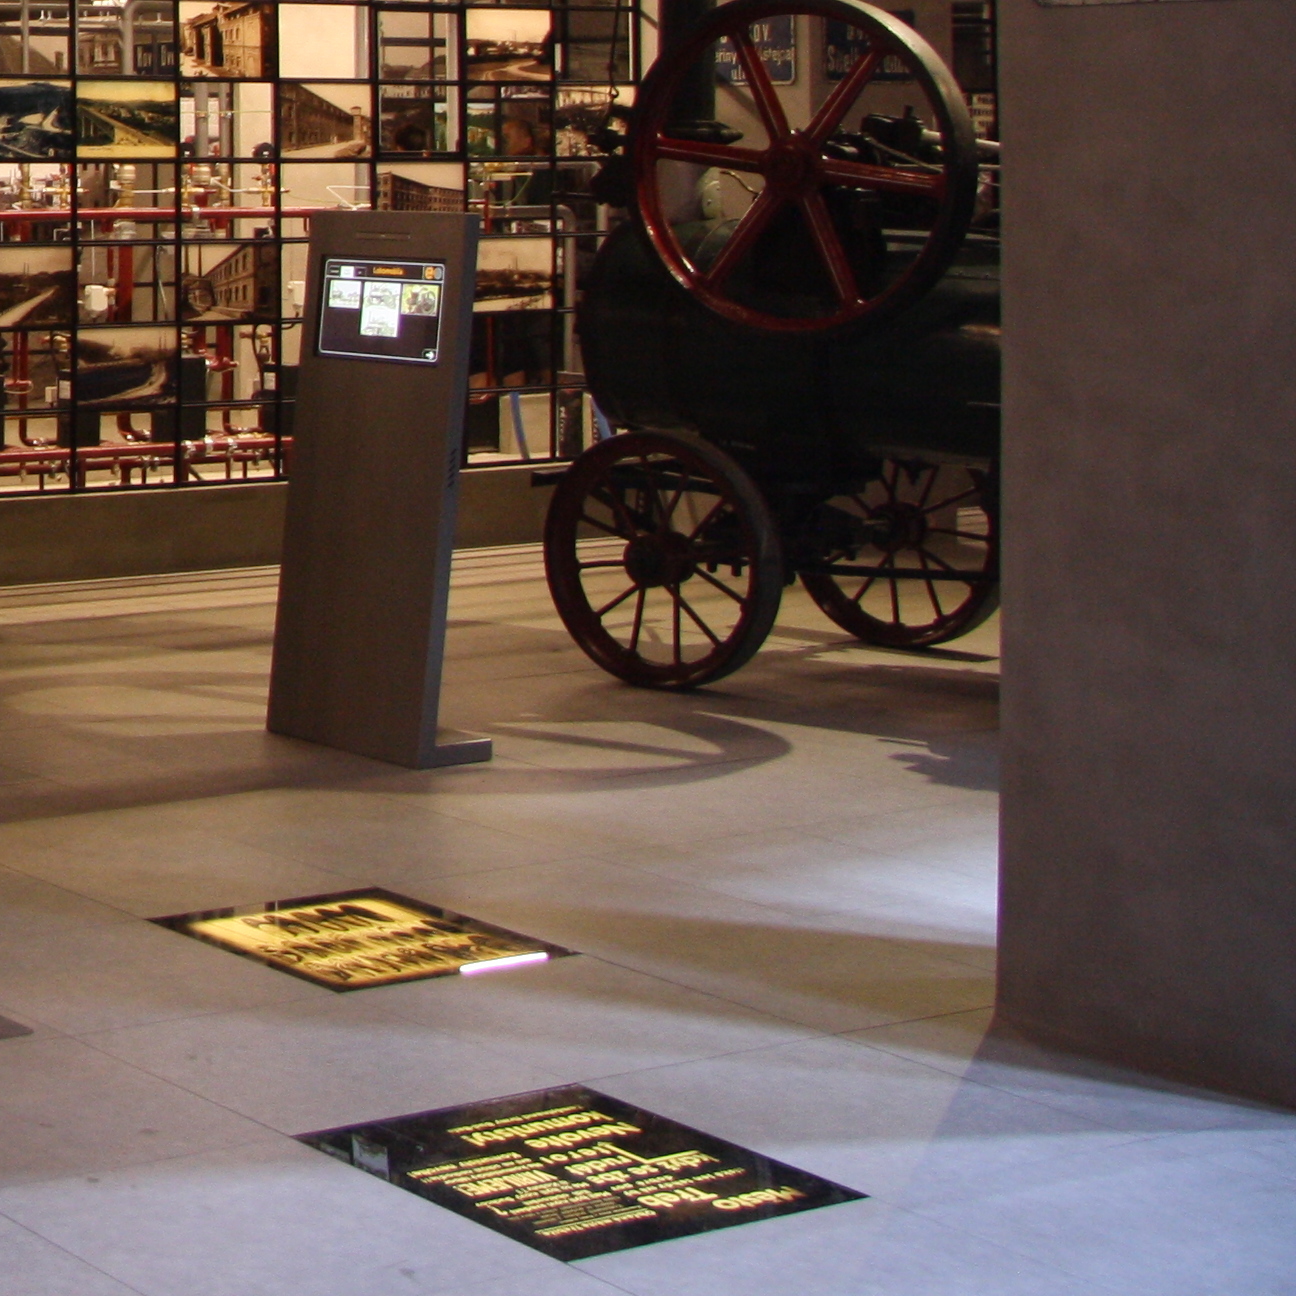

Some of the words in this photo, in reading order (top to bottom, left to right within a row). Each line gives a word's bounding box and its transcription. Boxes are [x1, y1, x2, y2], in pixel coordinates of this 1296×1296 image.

[461, 1111, 613, 1147] komunisty!
[524, 1121, 641, 1149] Nevolte
[452, 1169, 558, 1197] VARUJEME!
[711, 1185, 807, 1210] Město
